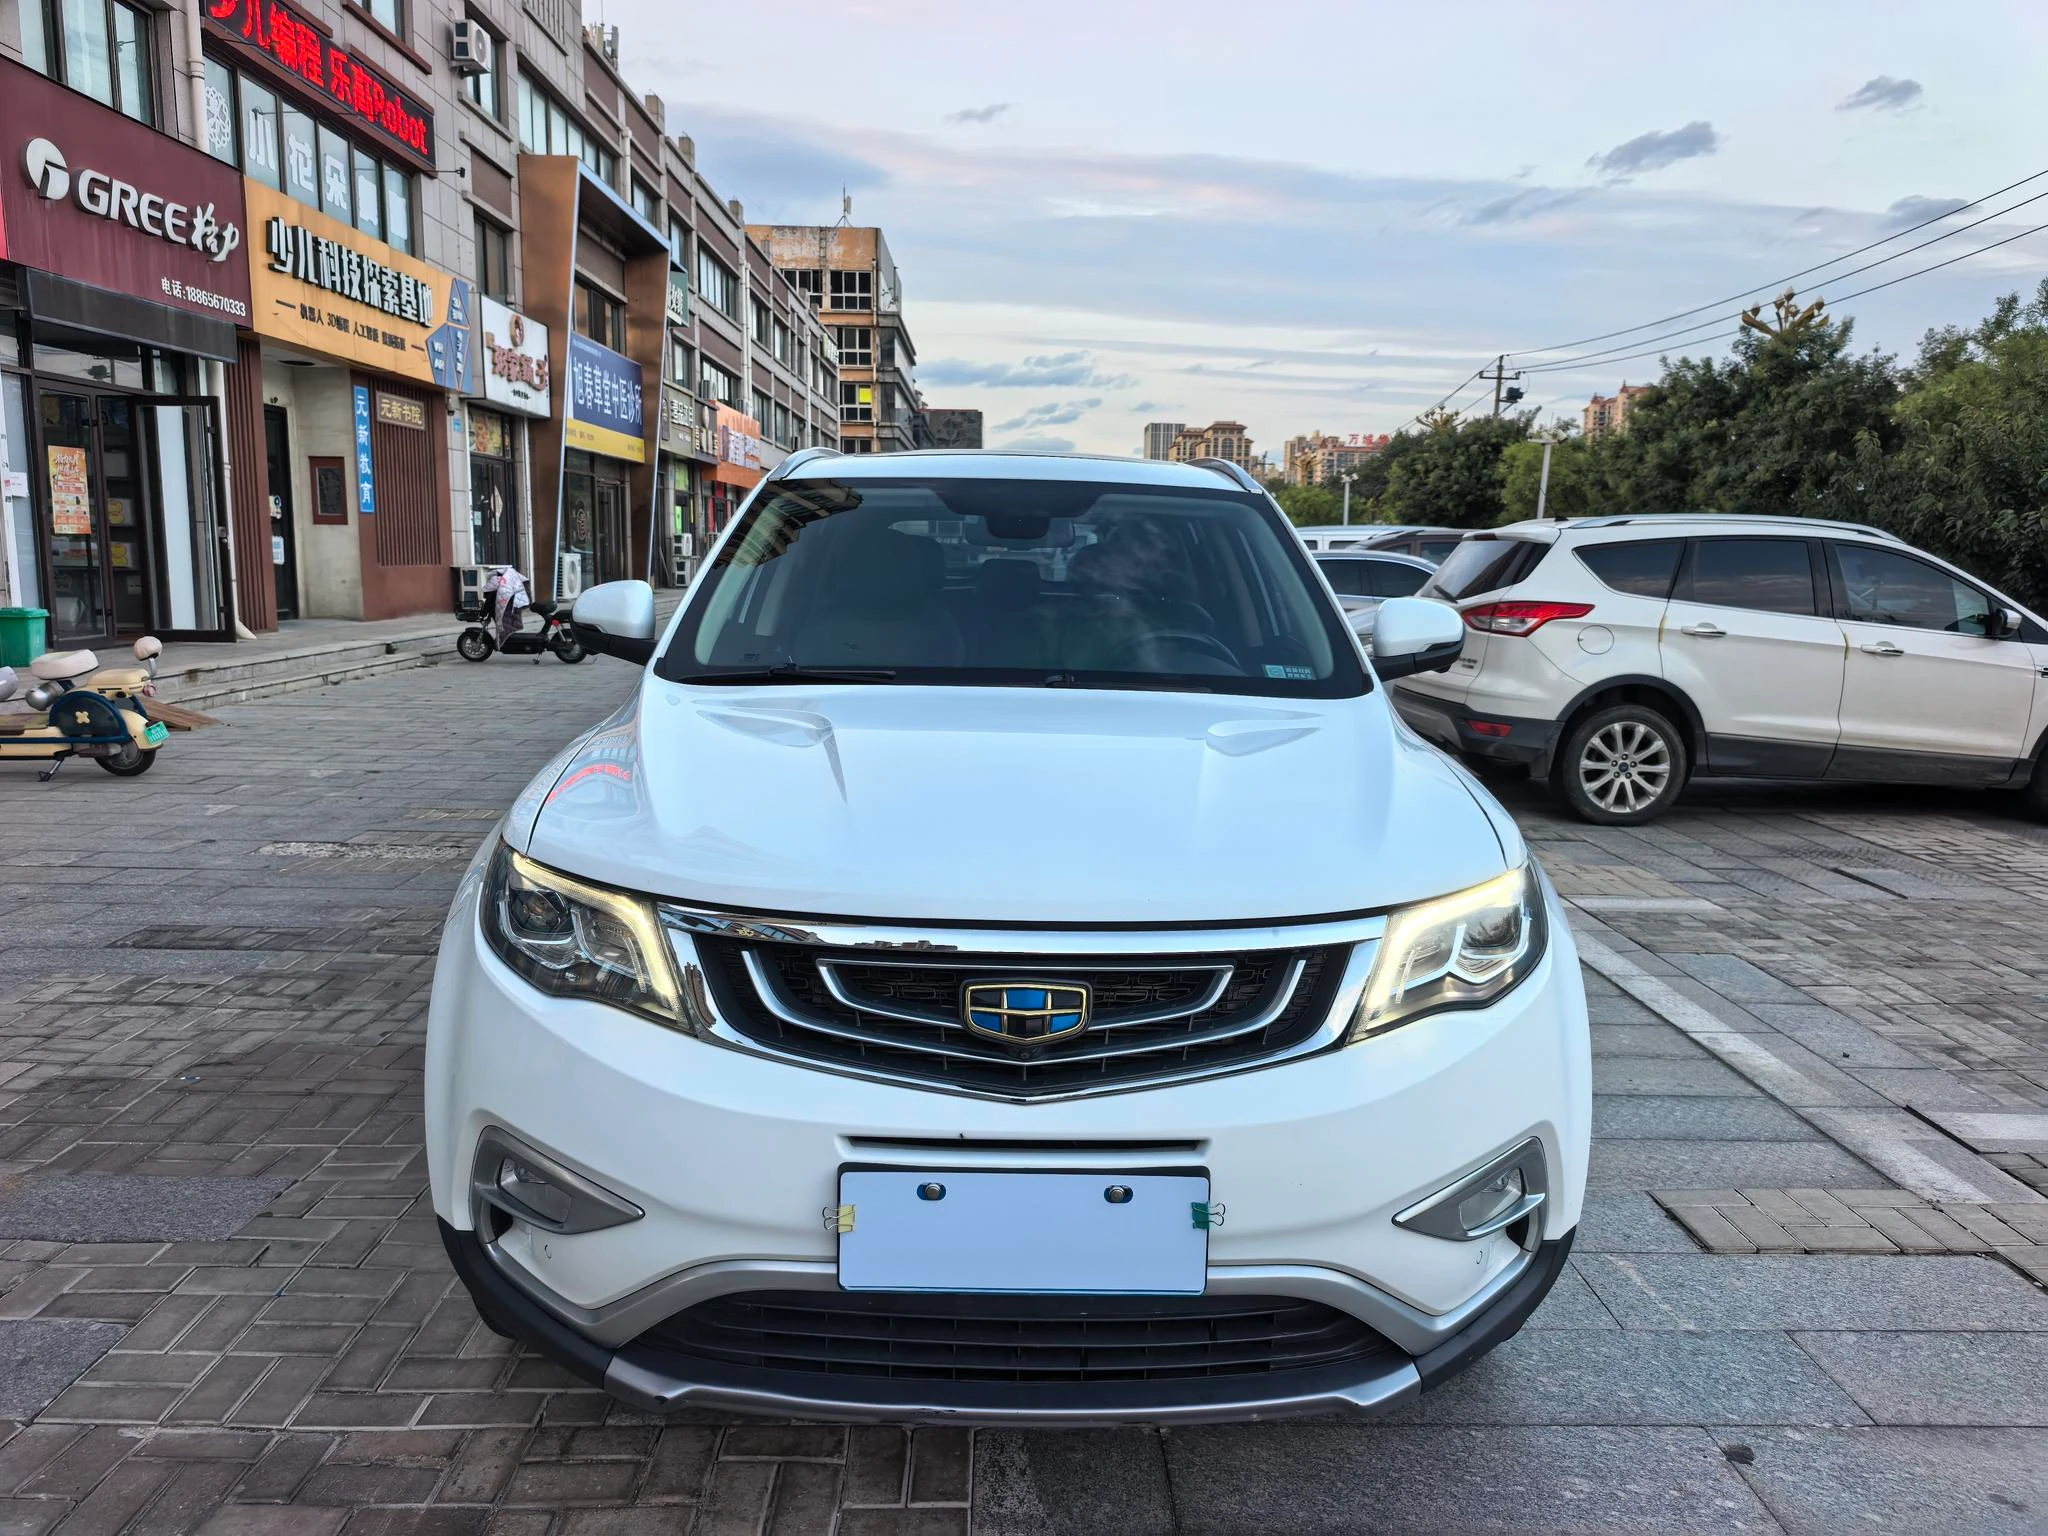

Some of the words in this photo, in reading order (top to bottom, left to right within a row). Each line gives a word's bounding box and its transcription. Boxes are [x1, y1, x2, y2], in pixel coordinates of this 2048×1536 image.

[78, 168, 187, 245] GREE
[191, 202, 240, 263] 格力
[272, 216, 434, 329] 少儿科技探索基地
[380, 399, 423, 424] 元新书院
